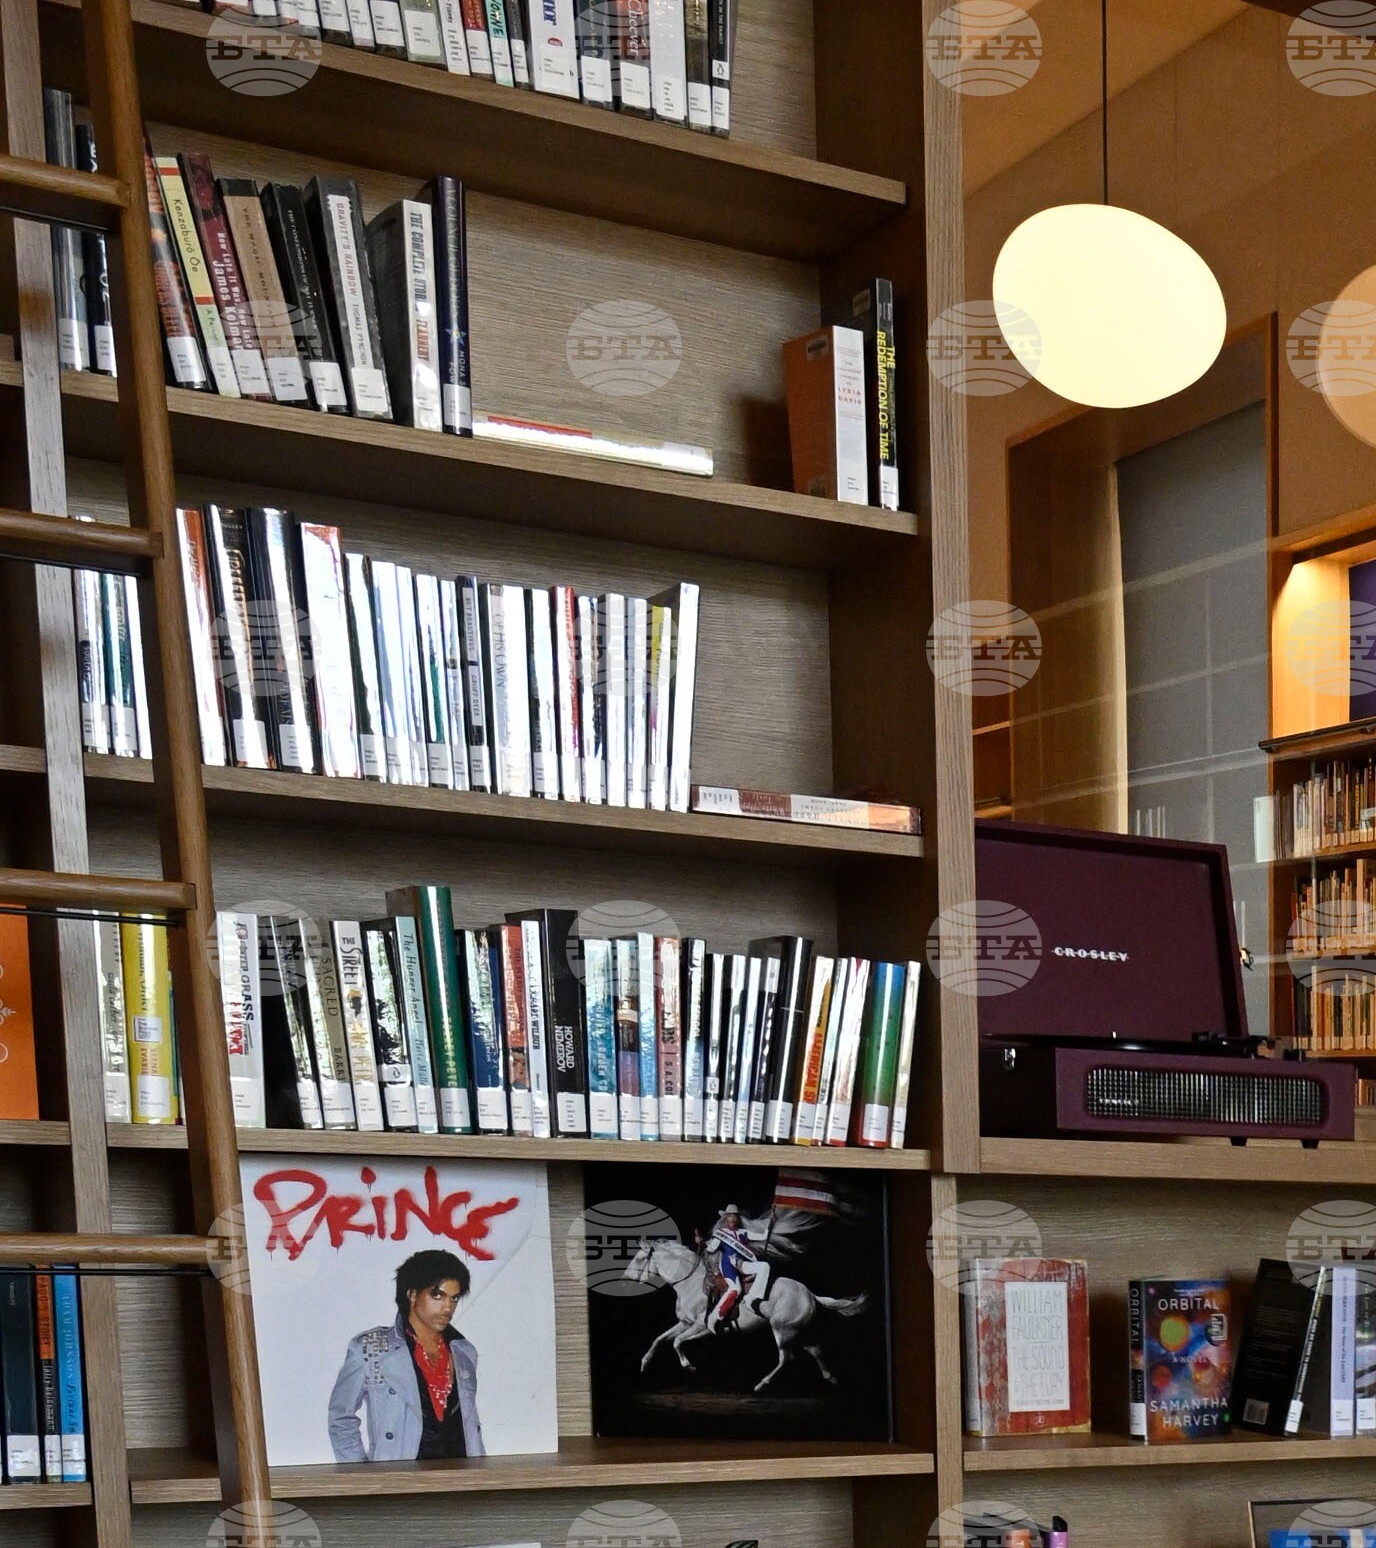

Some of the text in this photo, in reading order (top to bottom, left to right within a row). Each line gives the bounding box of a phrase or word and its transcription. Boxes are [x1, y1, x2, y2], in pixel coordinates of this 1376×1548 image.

[411, 232, 425, 276] COMPLETE
[212, 261, 230, 301] James
[877, 330, 889, 460] REDEMPTION TIME
[1053, 946, 1129, 962] CROSLEY
[555, 1025, 566, 1073] NEMEROV
[564, 1025, 575, 1068] HOWARD
[1129, 1288, 1139, 1348] ORBITAL
[1158, 1297, 1219, 1311] ORBITAL
[1151, 1398, 1228, 1413] SAMANTHA
[1162, 1414, 1218, 1429] HARVEY
